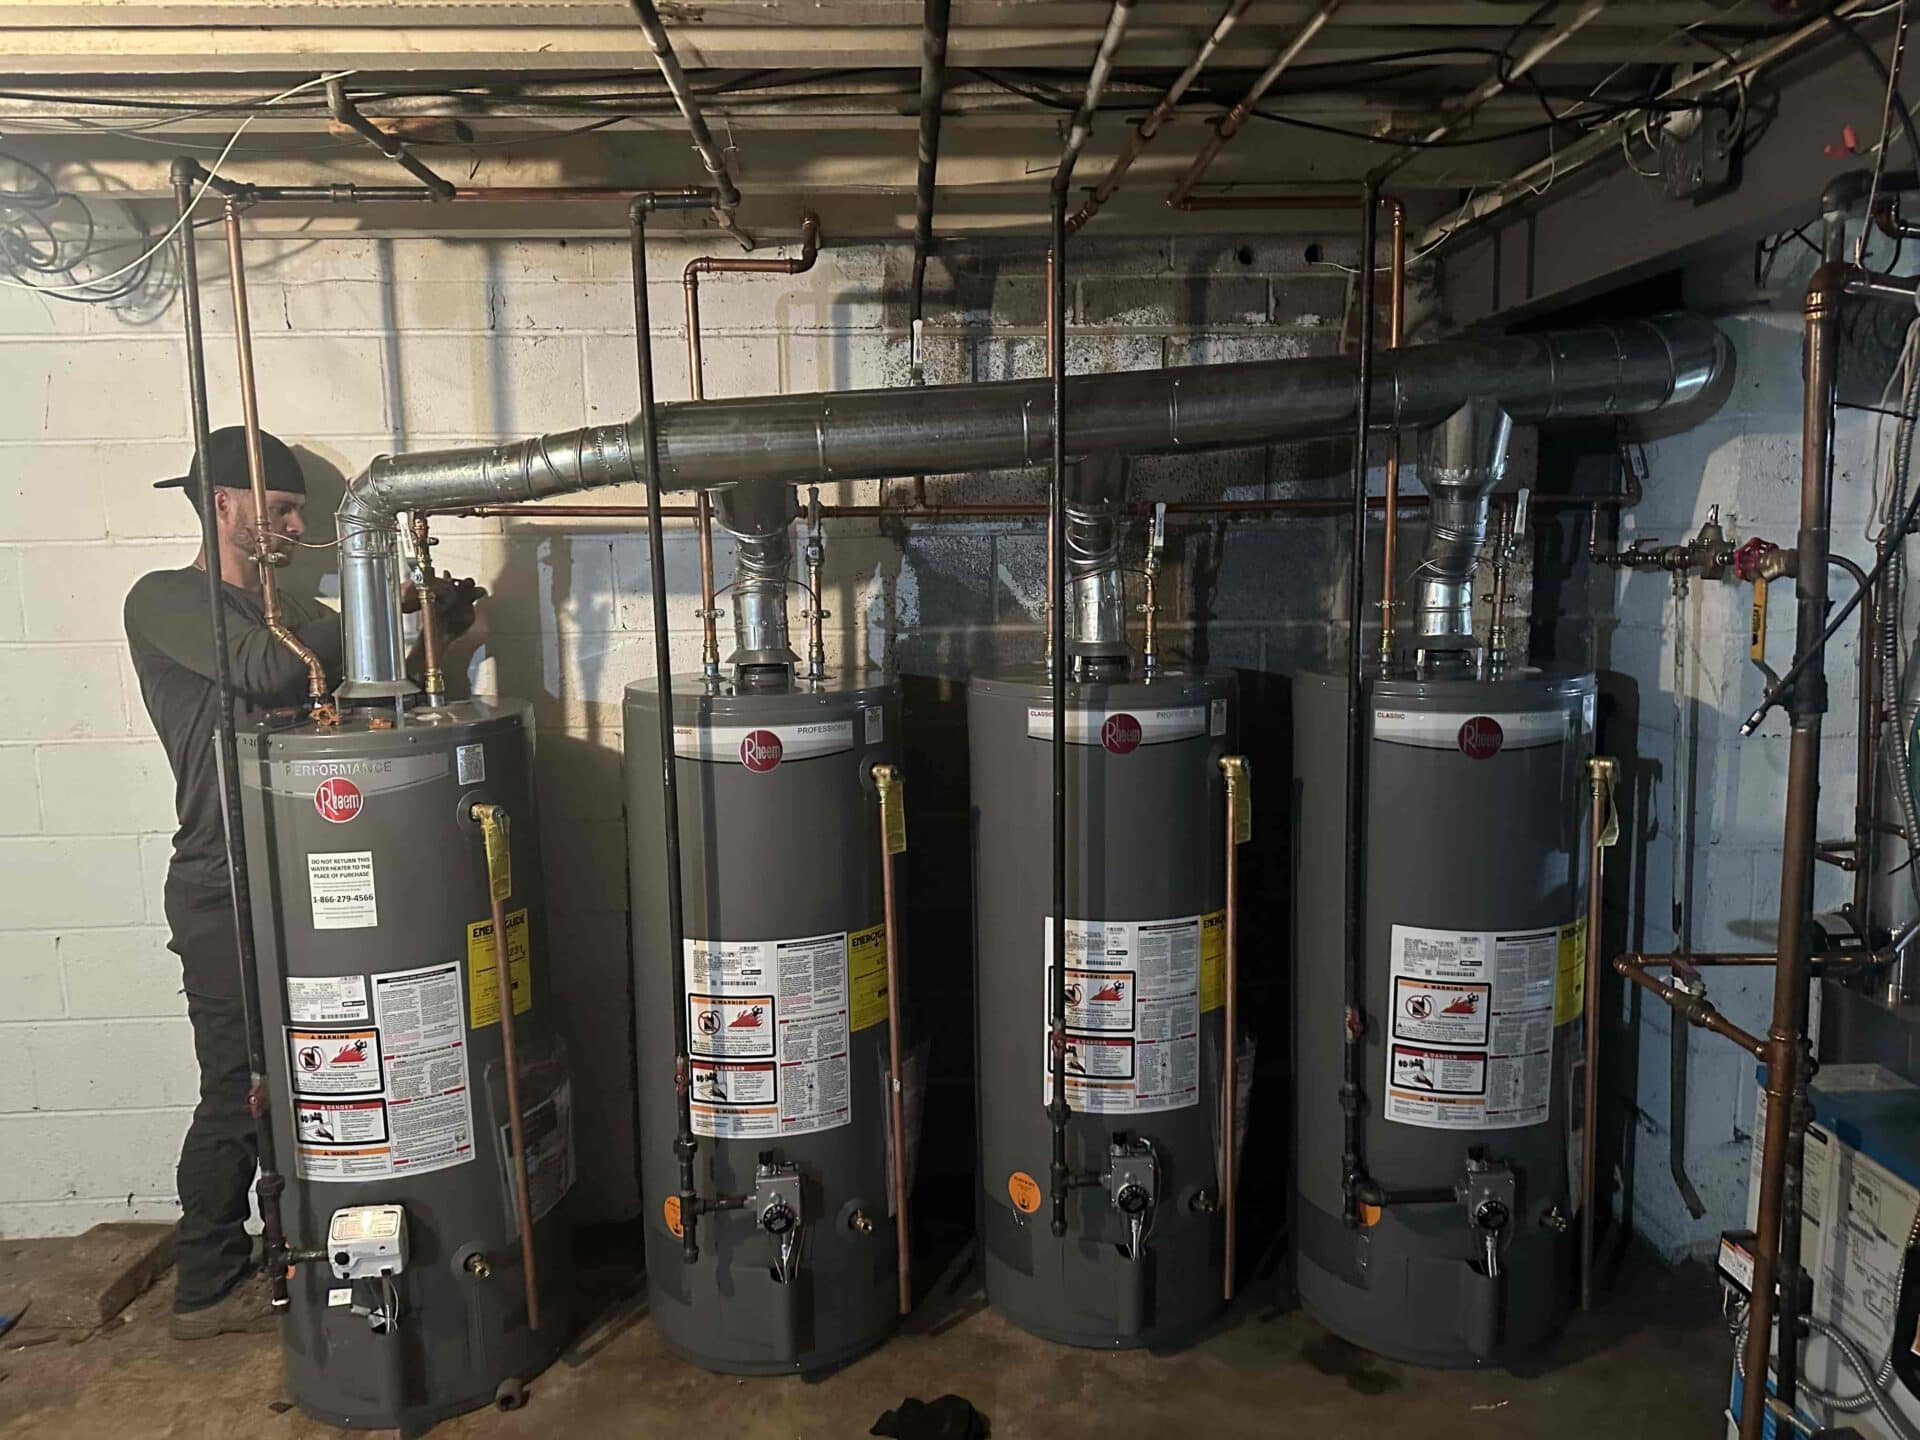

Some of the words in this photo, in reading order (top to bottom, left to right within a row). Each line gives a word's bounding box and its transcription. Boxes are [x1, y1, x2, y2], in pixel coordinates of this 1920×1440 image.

[1105, 714, 1140, 748] Rheem
[1463, 717, 1501, 752] Rheem
[744, 731, 780, 766] Rheem
[285, 761, 392, 776] PERFORMANCE
[320, 779, 360, 816] Rheem
[313, 893, 374, 904] 1-866-279-4566
